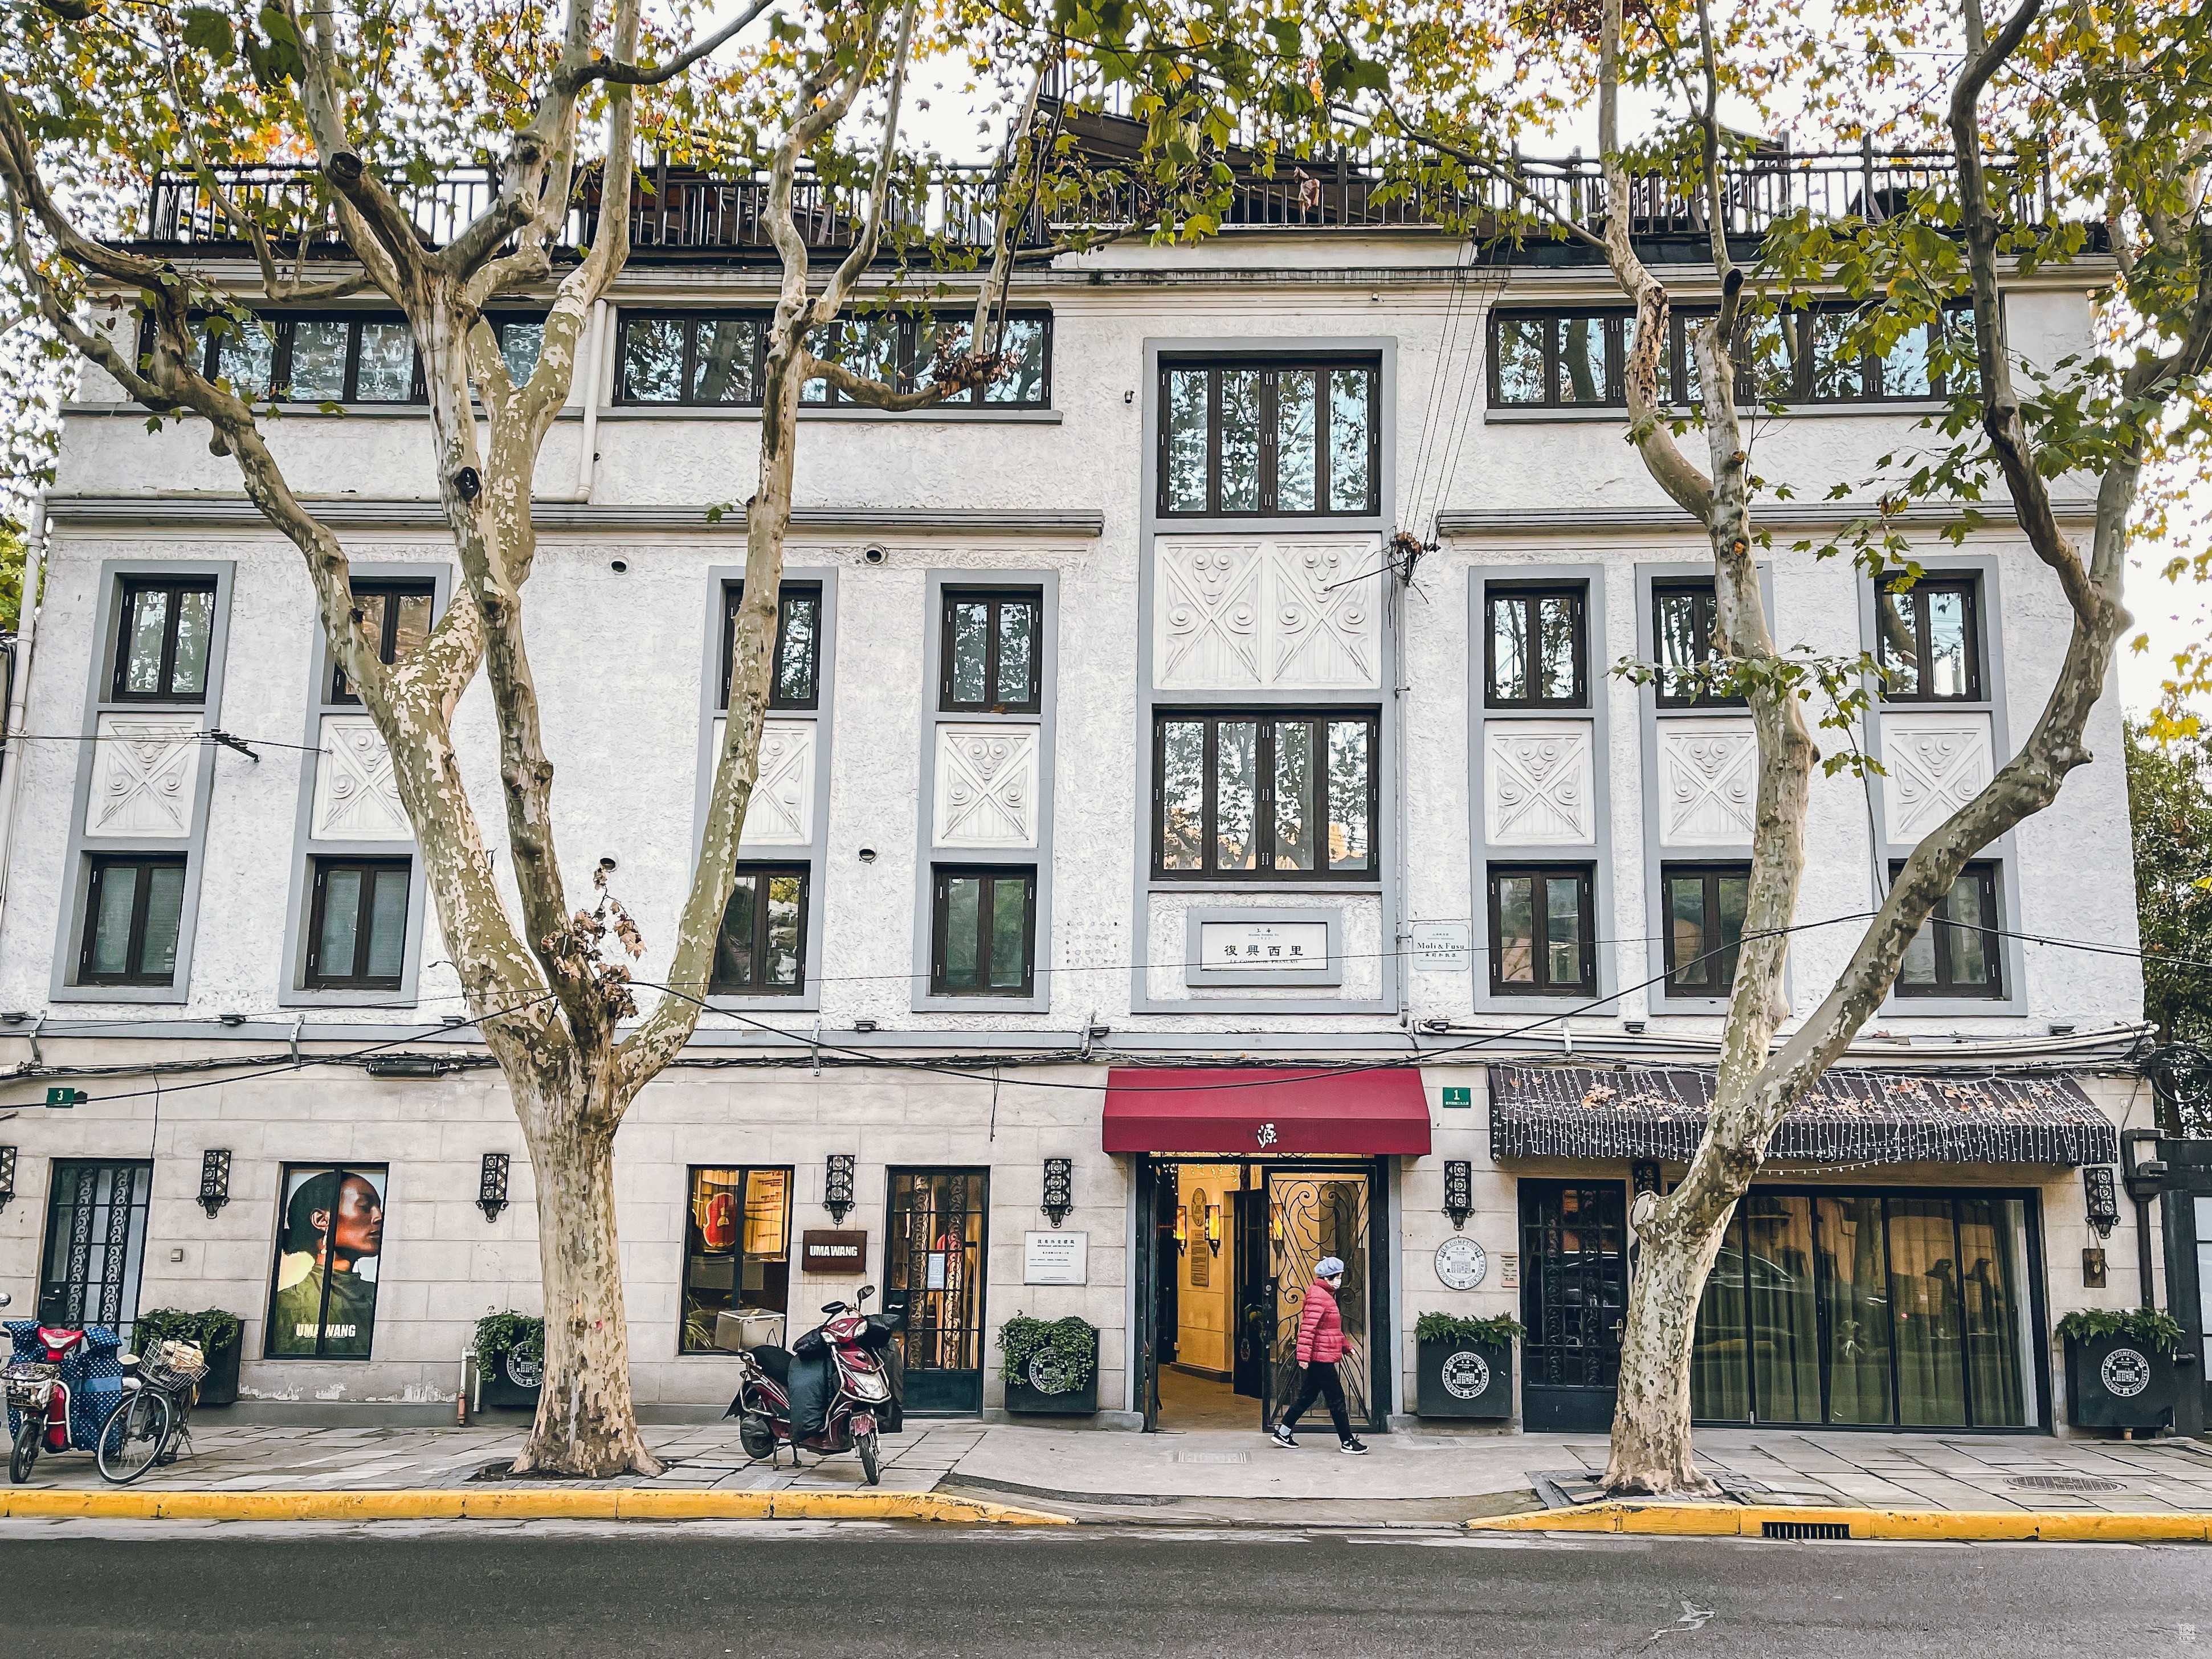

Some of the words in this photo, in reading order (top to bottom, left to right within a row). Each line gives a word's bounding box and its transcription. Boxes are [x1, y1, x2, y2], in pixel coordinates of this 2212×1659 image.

[1225, 945, 1303, 956] 復興西里
[58, 1090, 63, 1101] 3
[1454, 1089, 1460, 1100] 1
[809, 1245, 830, 1256] UMA
[830, 1245, 858, 1256] WANG
